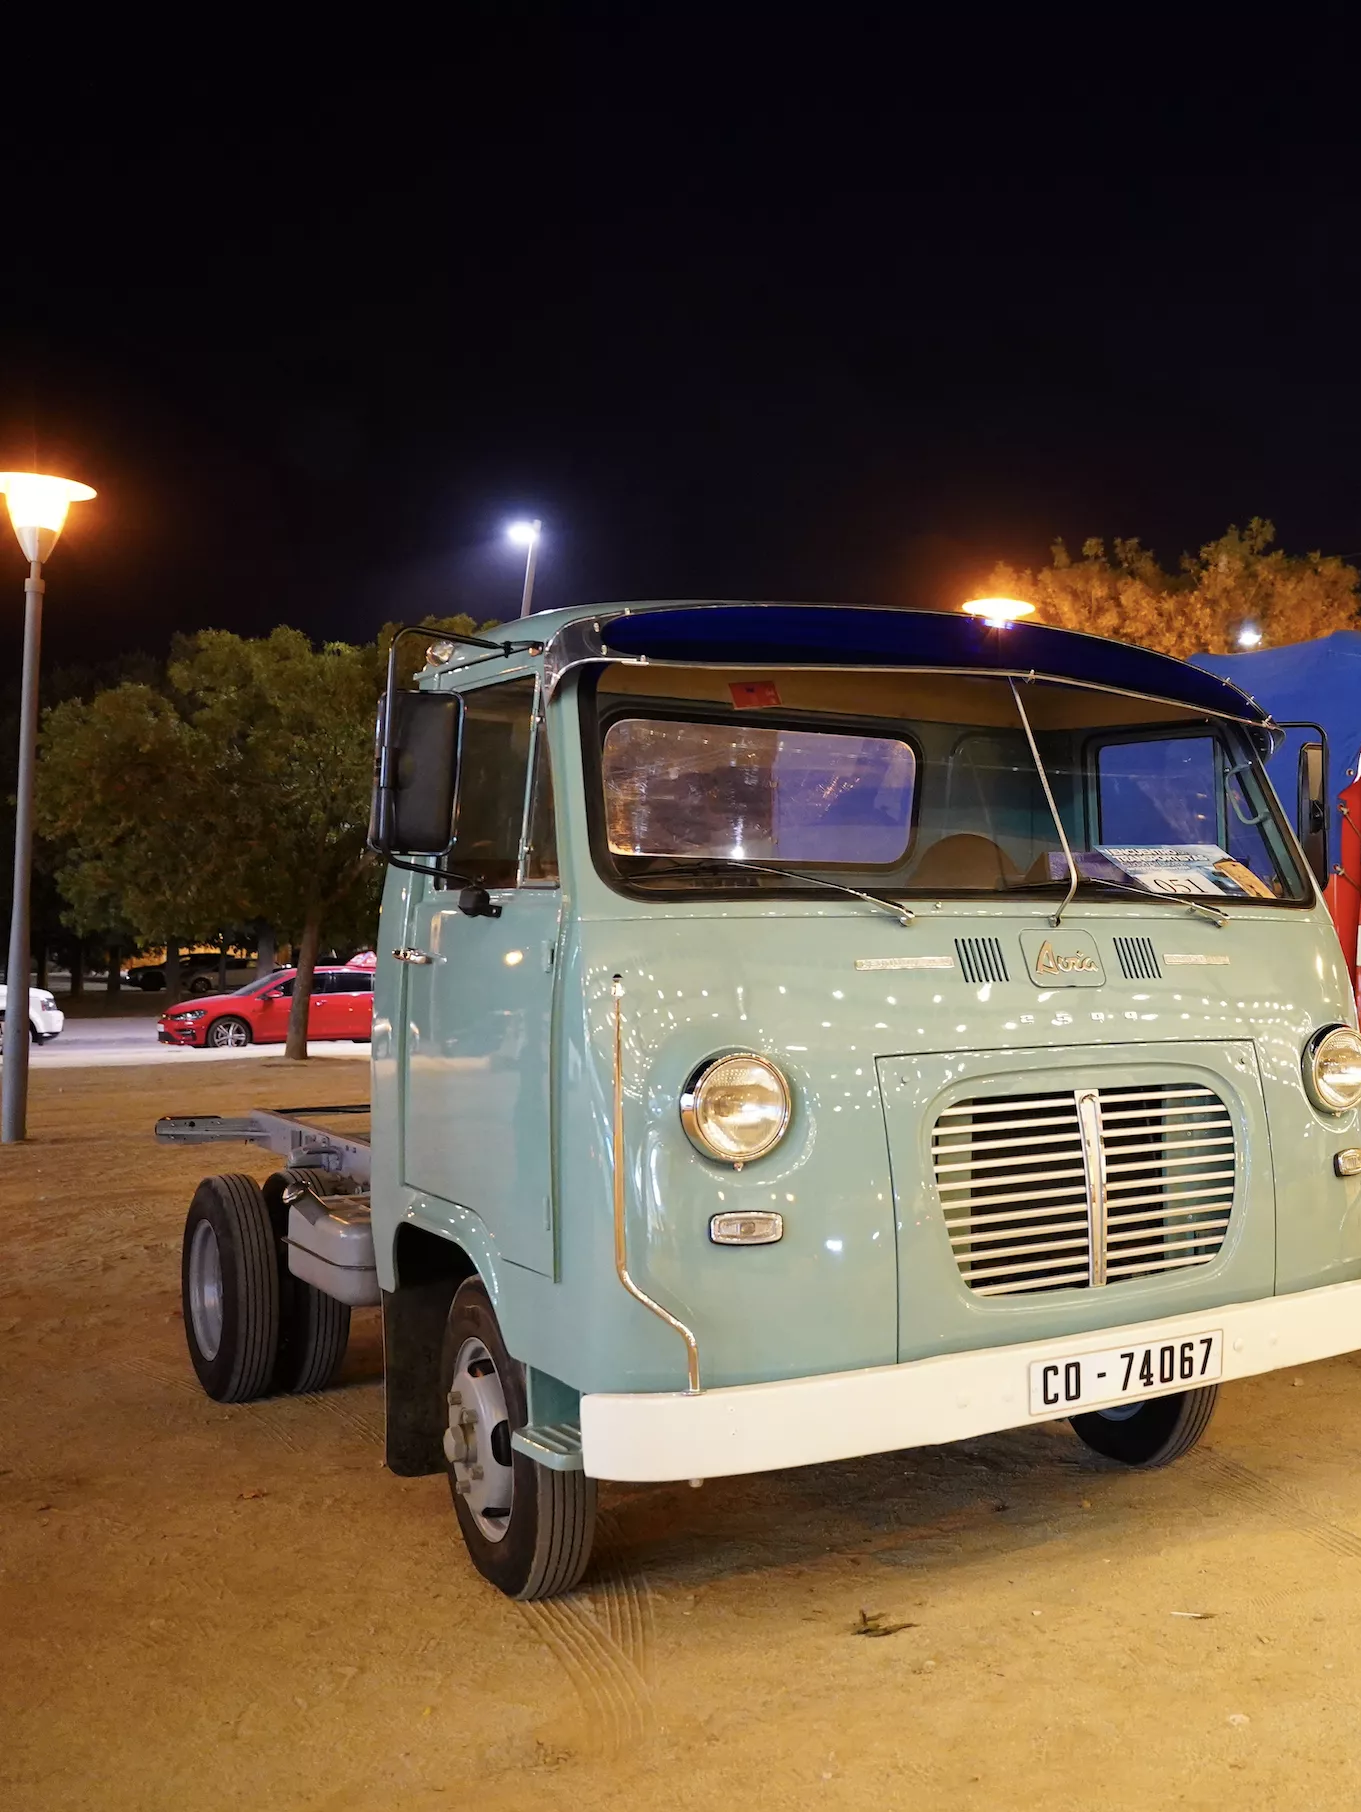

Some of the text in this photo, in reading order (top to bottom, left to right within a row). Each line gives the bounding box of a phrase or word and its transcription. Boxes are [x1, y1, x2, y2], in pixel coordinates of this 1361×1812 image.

[1108, 848, 1177, 856] ENCUENTRO
[1154, 878, 1209, 893] 051
[1035, 939, 1099, 976] Avia
